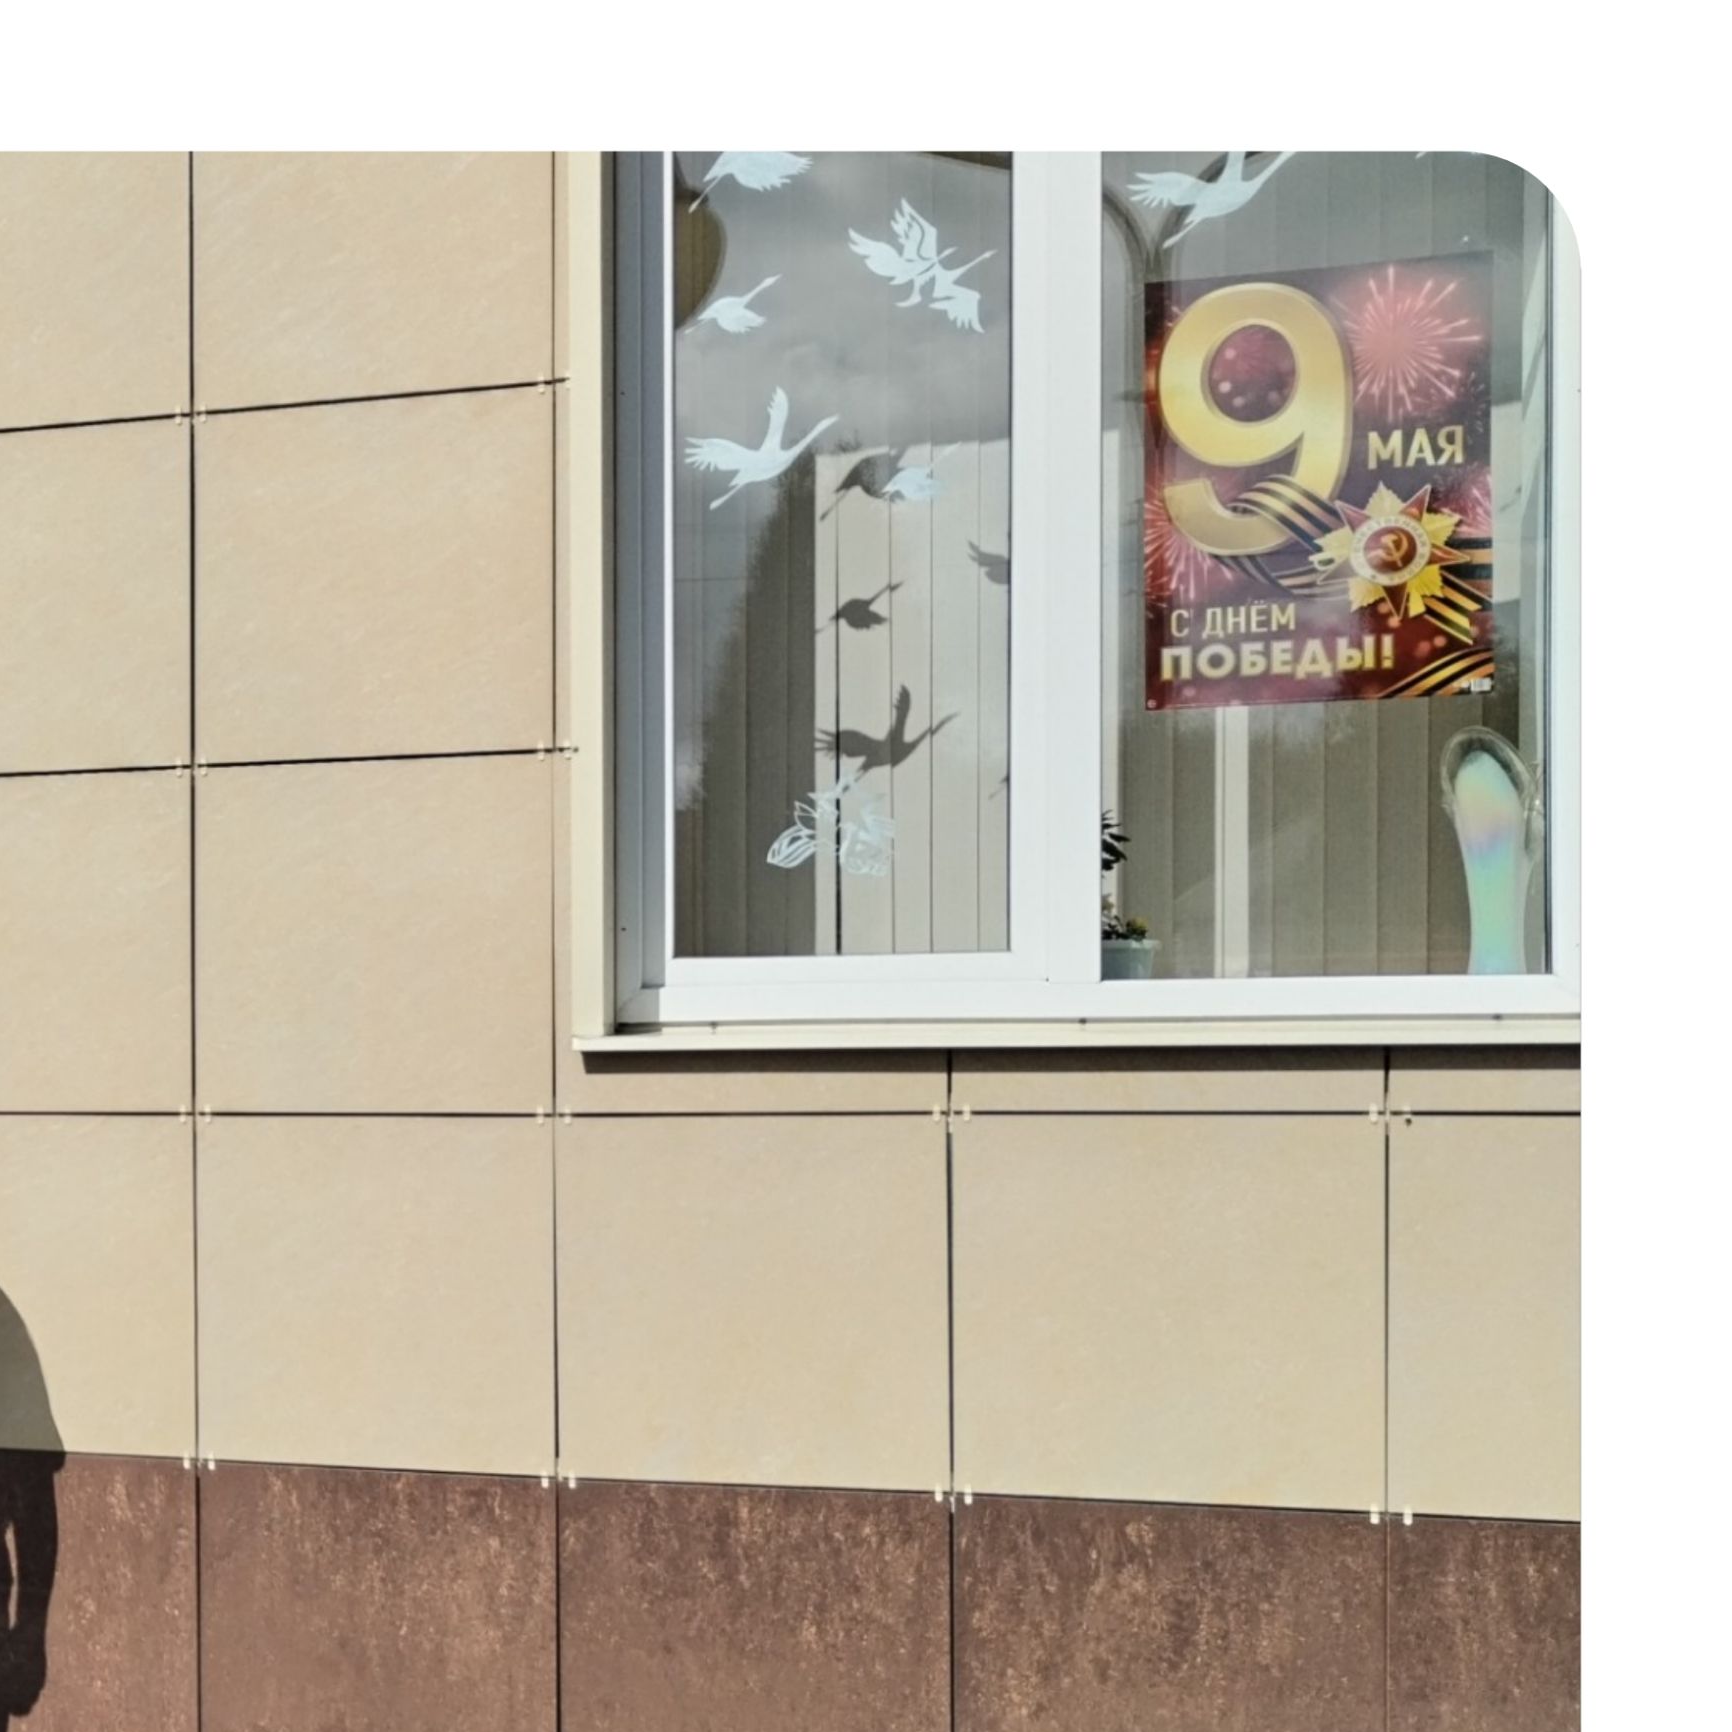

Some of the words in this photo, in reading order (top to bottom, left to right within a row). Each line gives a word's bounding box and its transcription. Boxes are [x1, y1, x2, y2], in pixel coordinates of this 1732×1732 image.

[1158, 281, 1353, 557] 9
[1368, 425, 1465, 470] МАЯ
[1170, 609, 1189, 637] С
[1202, 600, 1297, 638] ДНЁМ
[1160, 634, 1395, 681] ПОБЕДЫ!
